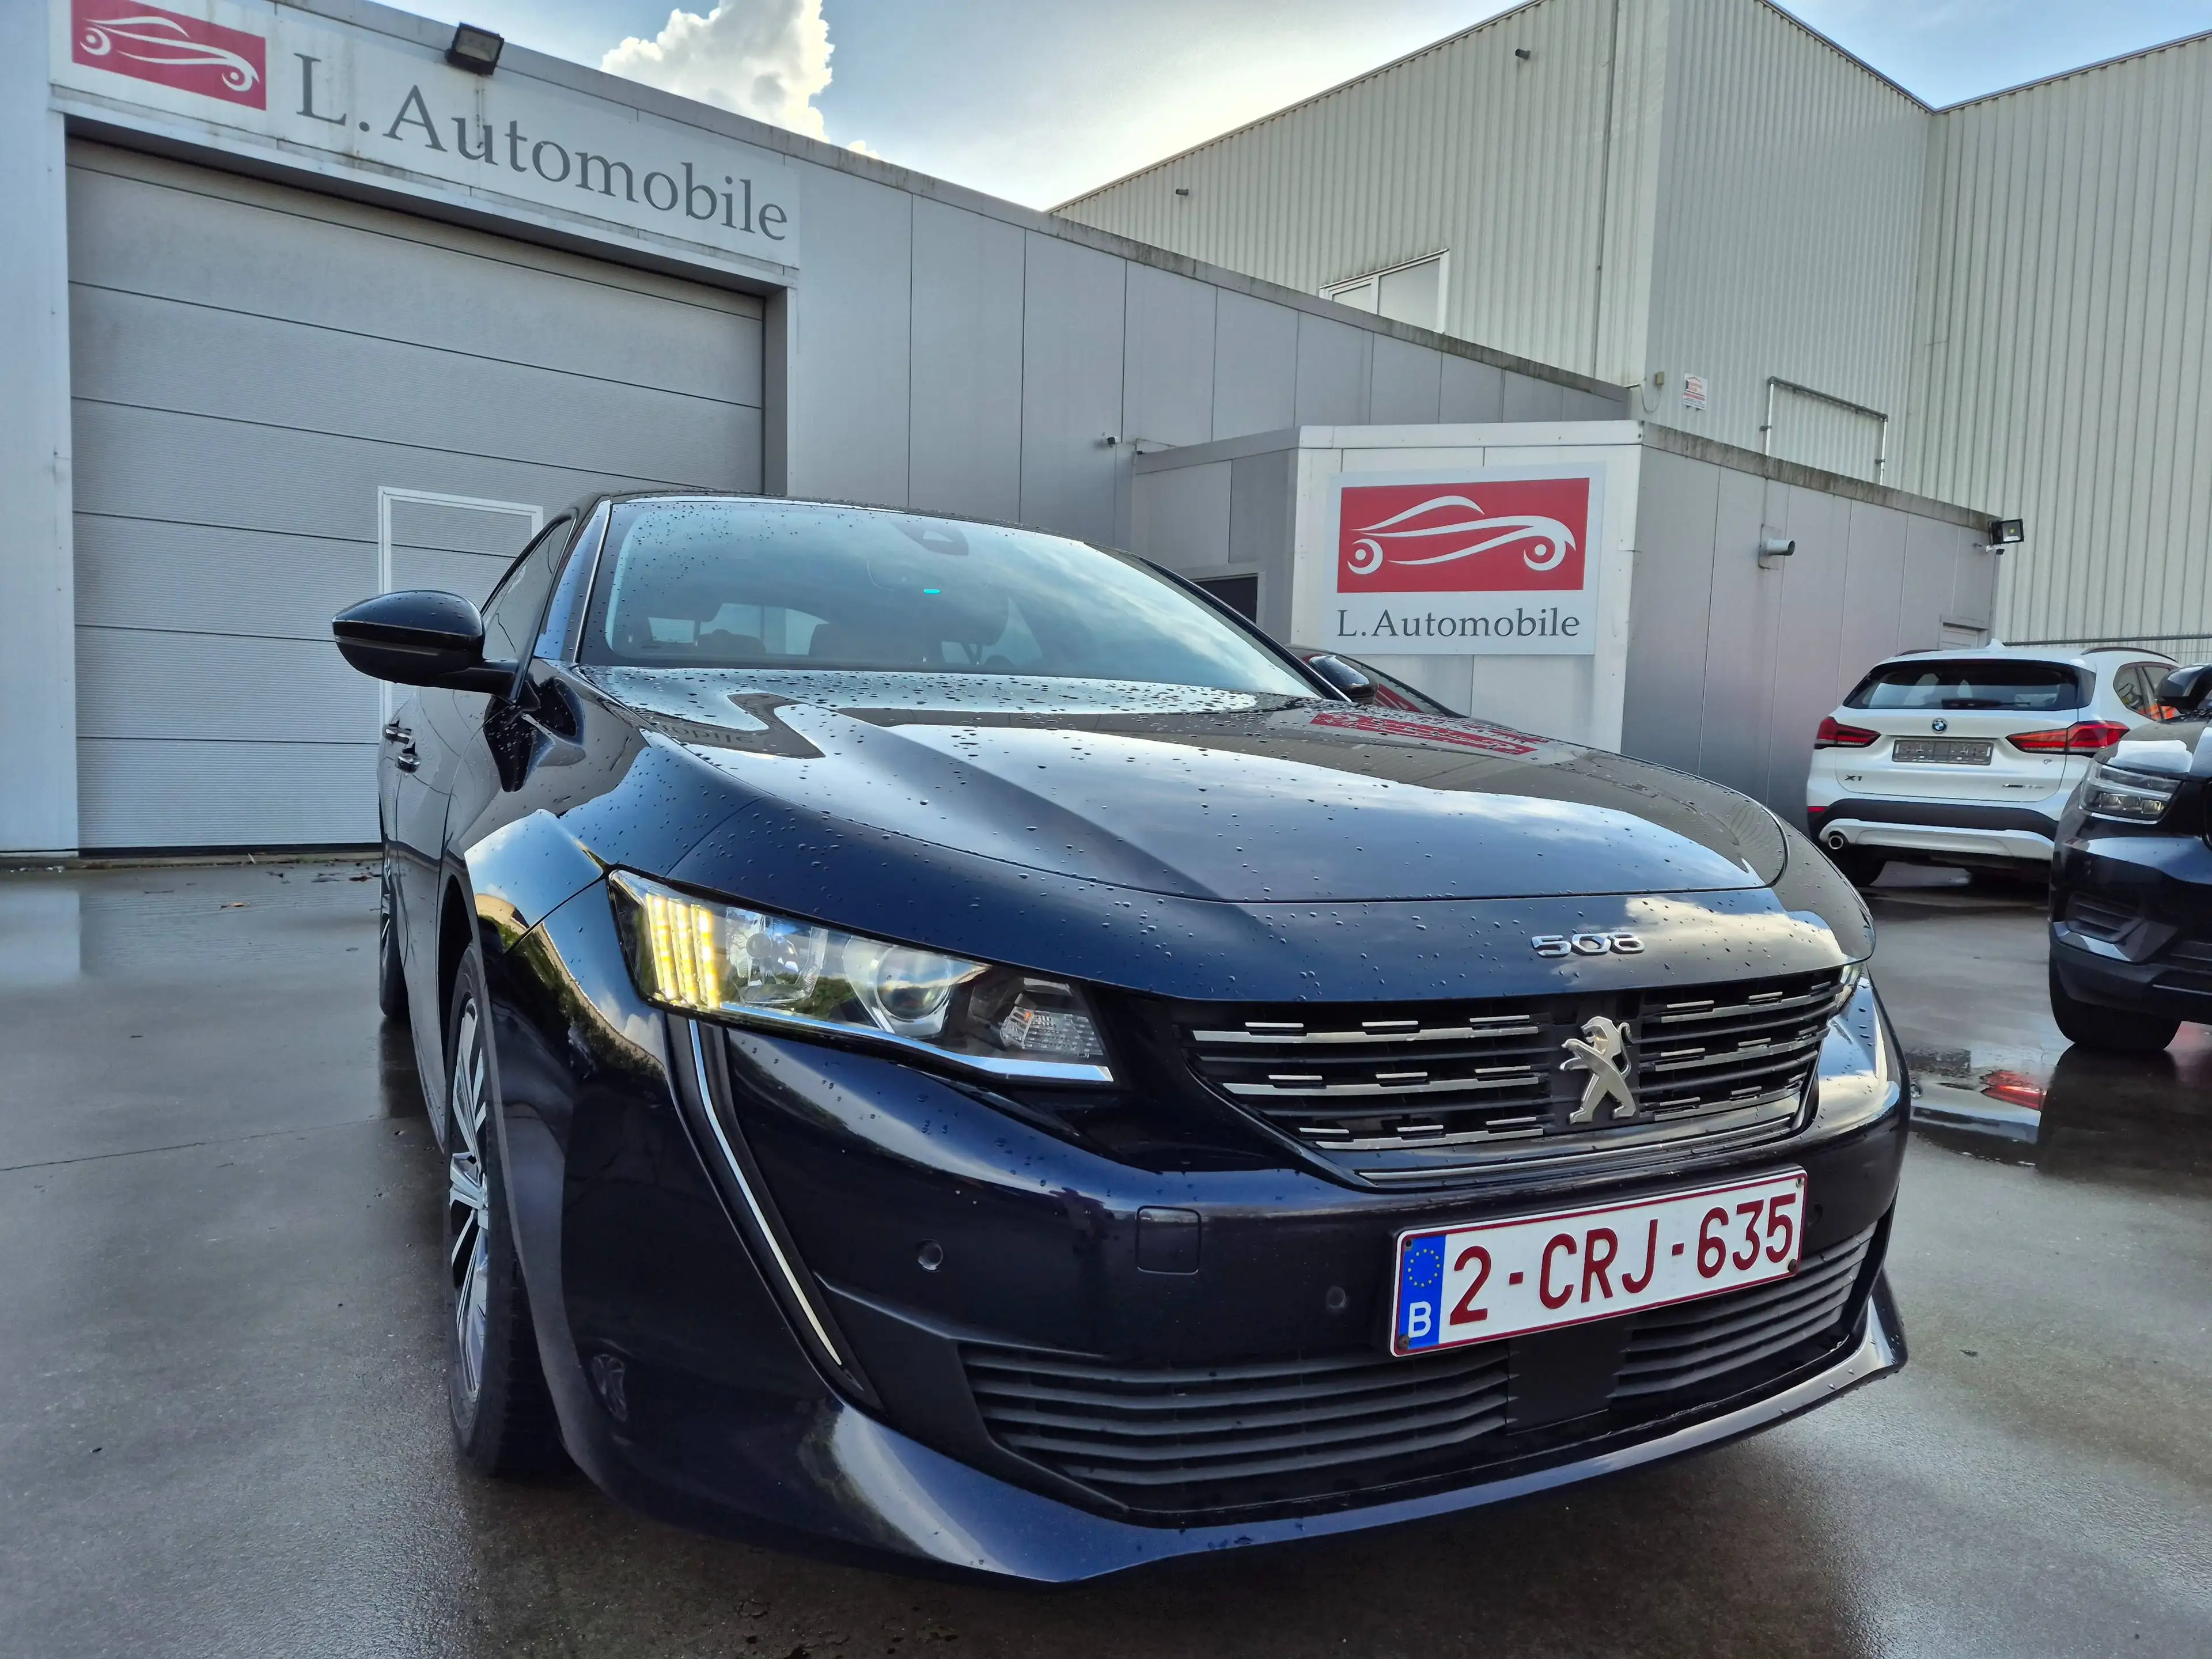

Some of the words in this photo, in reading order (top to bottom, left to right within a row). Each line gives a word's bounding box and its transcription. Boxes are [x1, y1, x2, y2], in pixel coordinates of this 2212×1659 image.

[294, 52, 787, 241] L.Automobile
[1336, 607, 1580, 637] L.Automobile
[1531, 932, 1645, 957] 508
[1408, 1301, 1432, 1338] B
[1449, 1192, 1797, 1326] 2-CRJ-635
